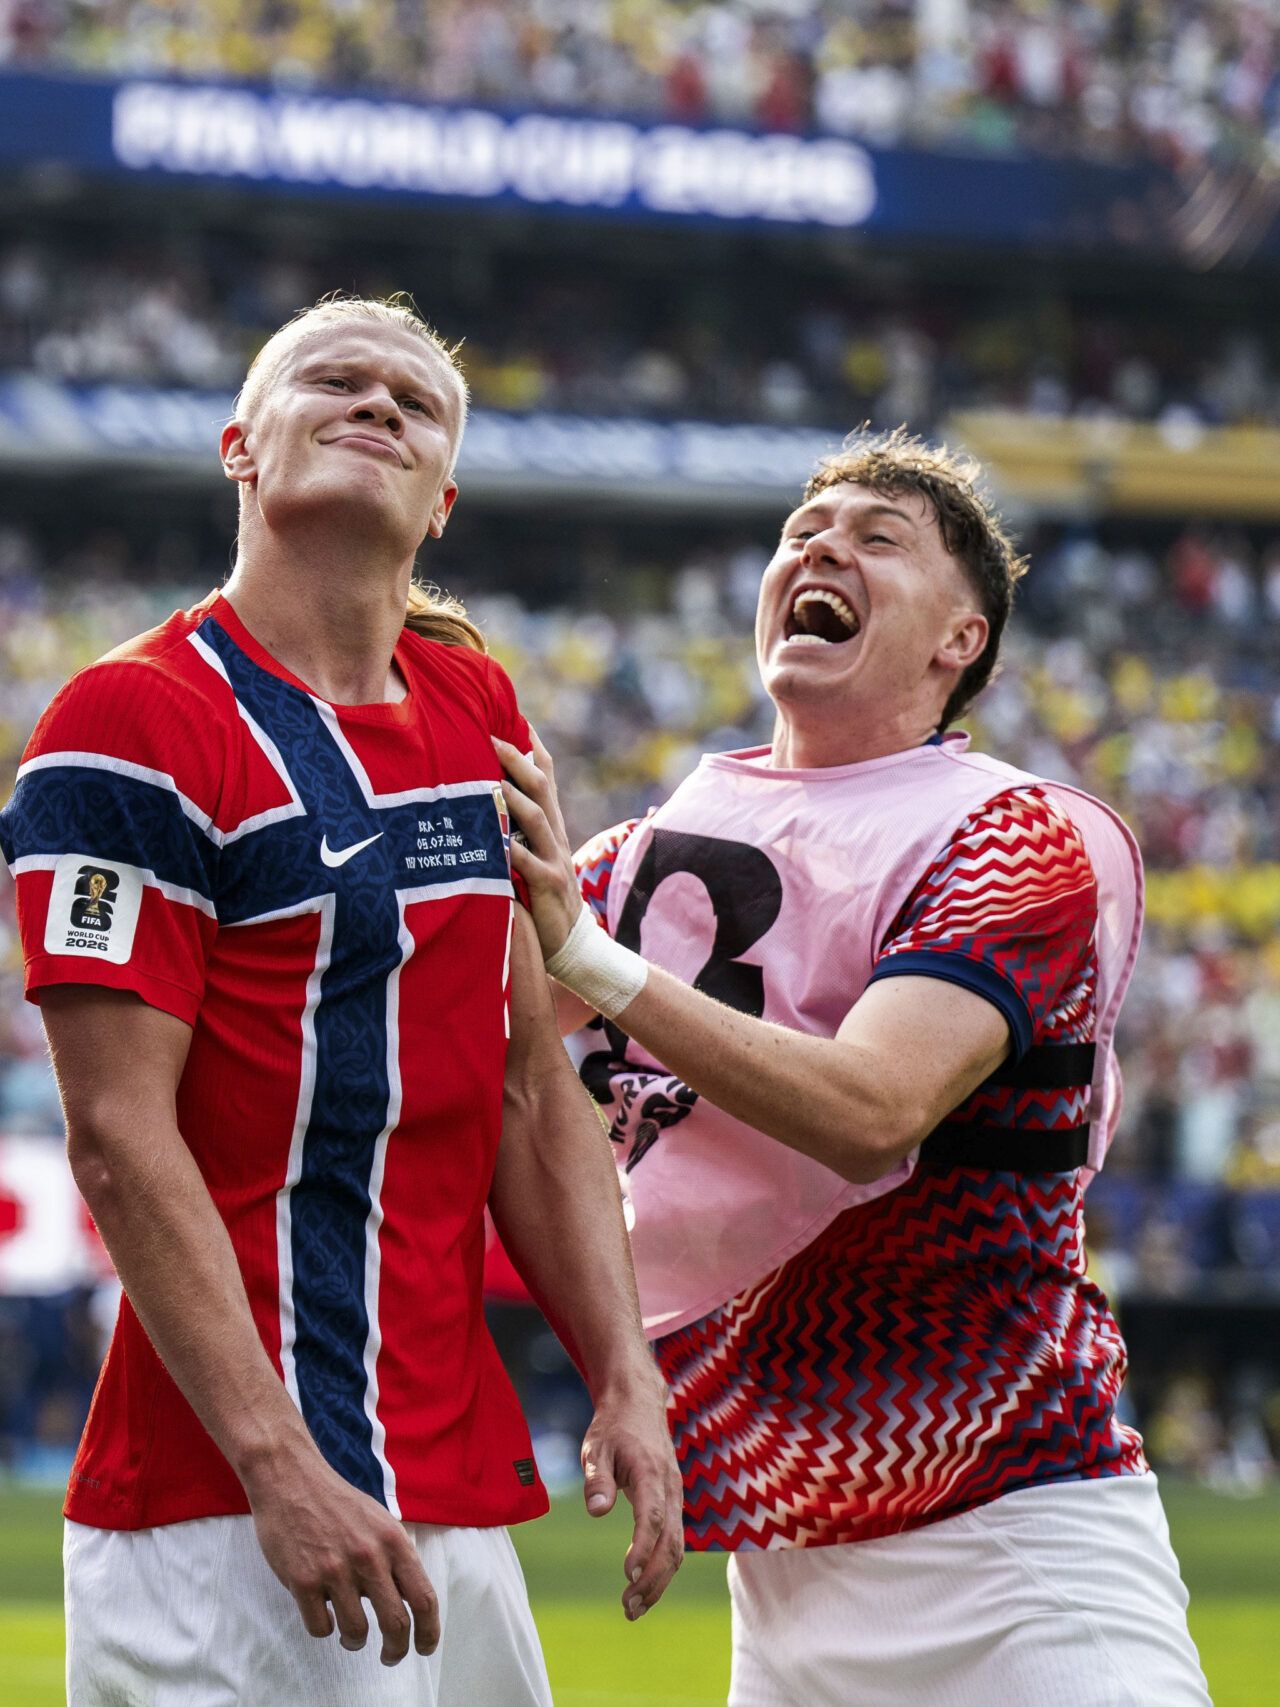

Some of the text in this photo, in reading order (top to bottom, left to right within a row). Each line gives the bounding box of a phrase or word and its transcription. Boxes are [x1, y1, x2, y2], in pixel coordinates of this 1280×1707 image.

[418, 820, 434, 832] BRA
[417, 854, 443, 868] YORK
[459, 849, 486, 863] JERSEY
[81, 916, 101, 926] FIFA
[67, 930, 109, 942] WORLD CUP
[65, 938, 108, 951] 2026
